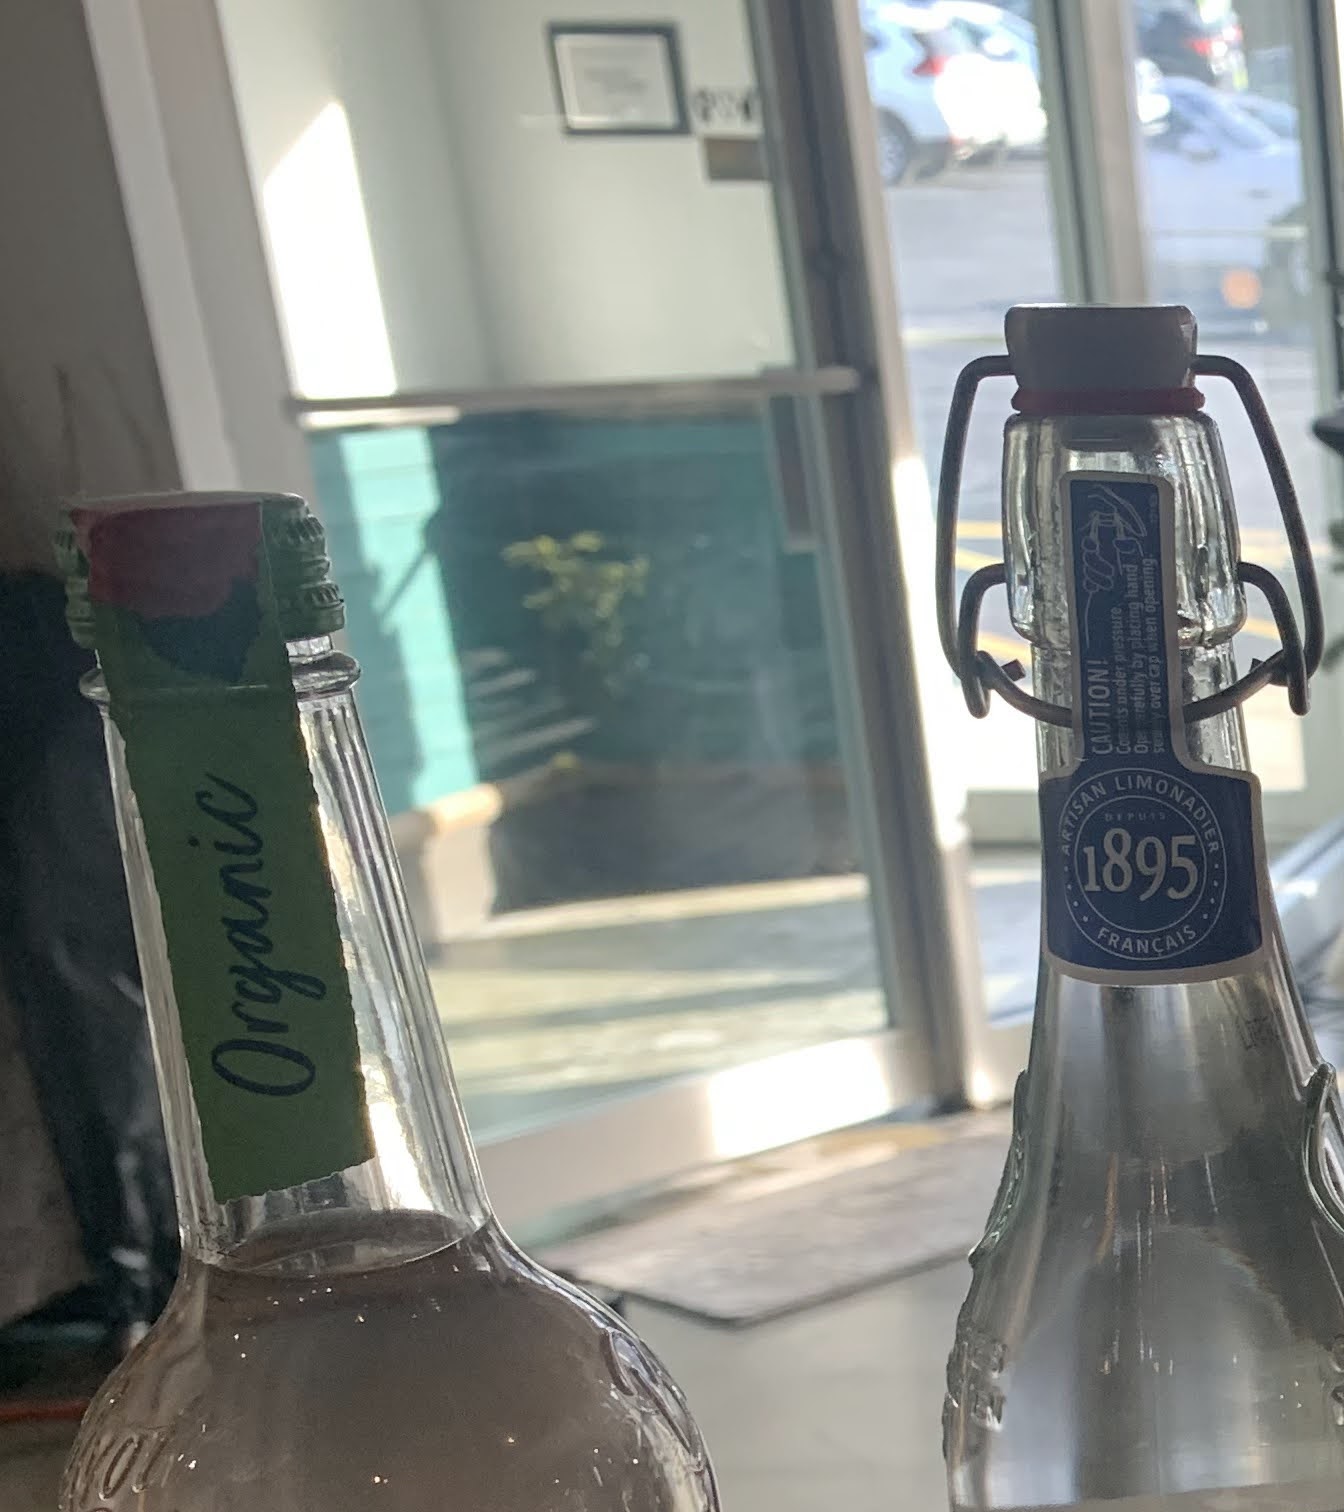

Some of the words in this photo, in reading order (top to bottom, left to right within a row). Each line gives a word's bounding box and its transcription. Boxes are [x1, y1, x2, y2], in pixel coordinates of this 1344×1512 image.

[1122, 563, 1139, 598] hand
[1087, 659, 1113, 755] CAUTION!
[1061, 780, 1107, 856] ARTISAN
[1115, 774, 1220, 853] LIMONADIER
[1083, 828, 1199, 901] 1895
[188, 770, 327, 1096] Organic
[1097, 924, 1197, 957] FRANÇAIS
